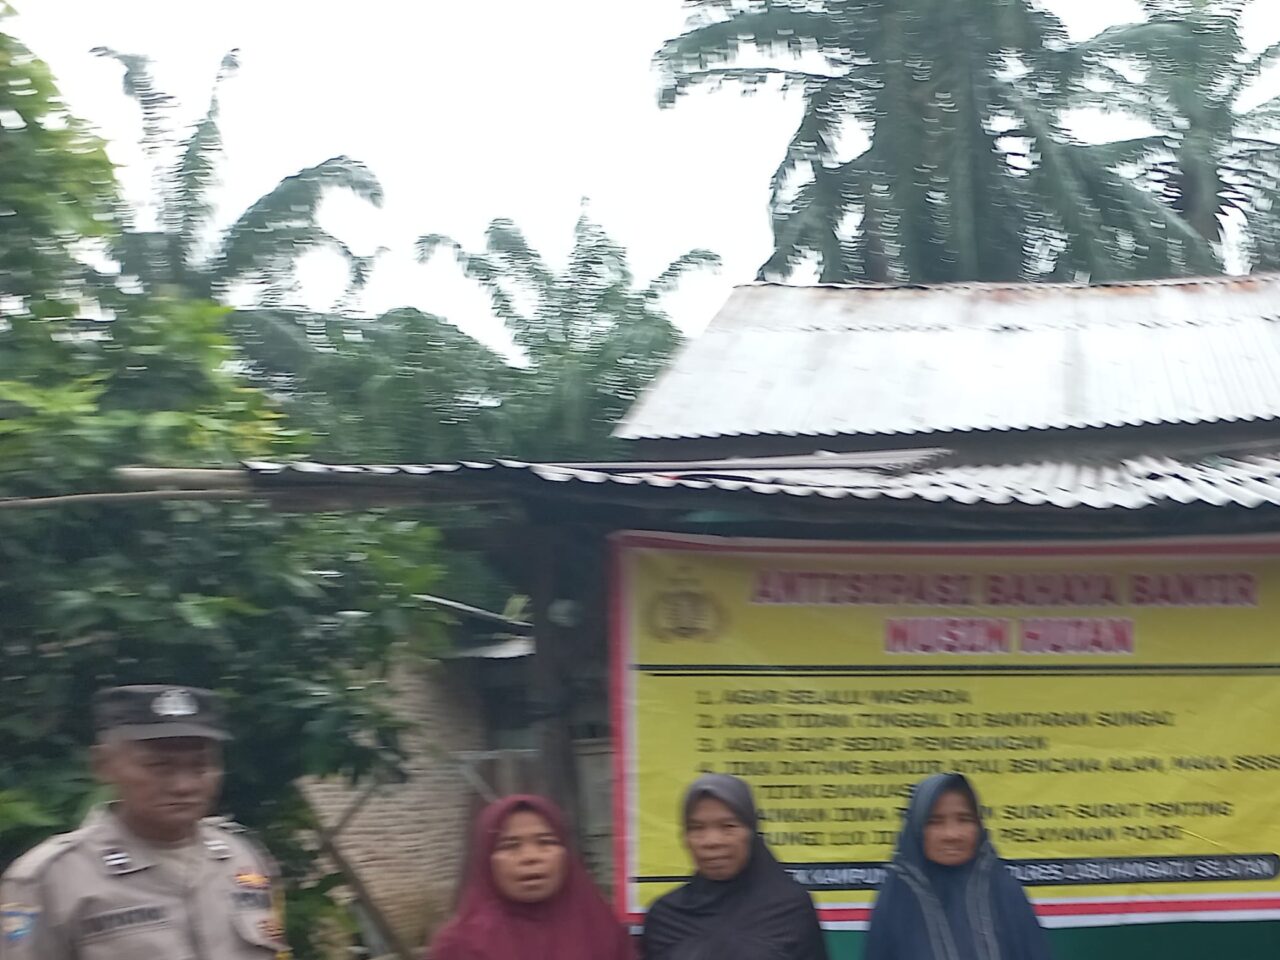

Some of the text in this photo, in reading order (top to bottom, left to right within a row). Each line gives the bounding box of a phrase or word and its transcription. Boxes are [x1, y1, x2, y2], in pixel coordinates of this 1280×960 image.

[750, 570, 978, 605] ANTISIPASI
[981, 572, 1122, 607] BAHAYA
[884, 617, 1011, 655] MUSIM
